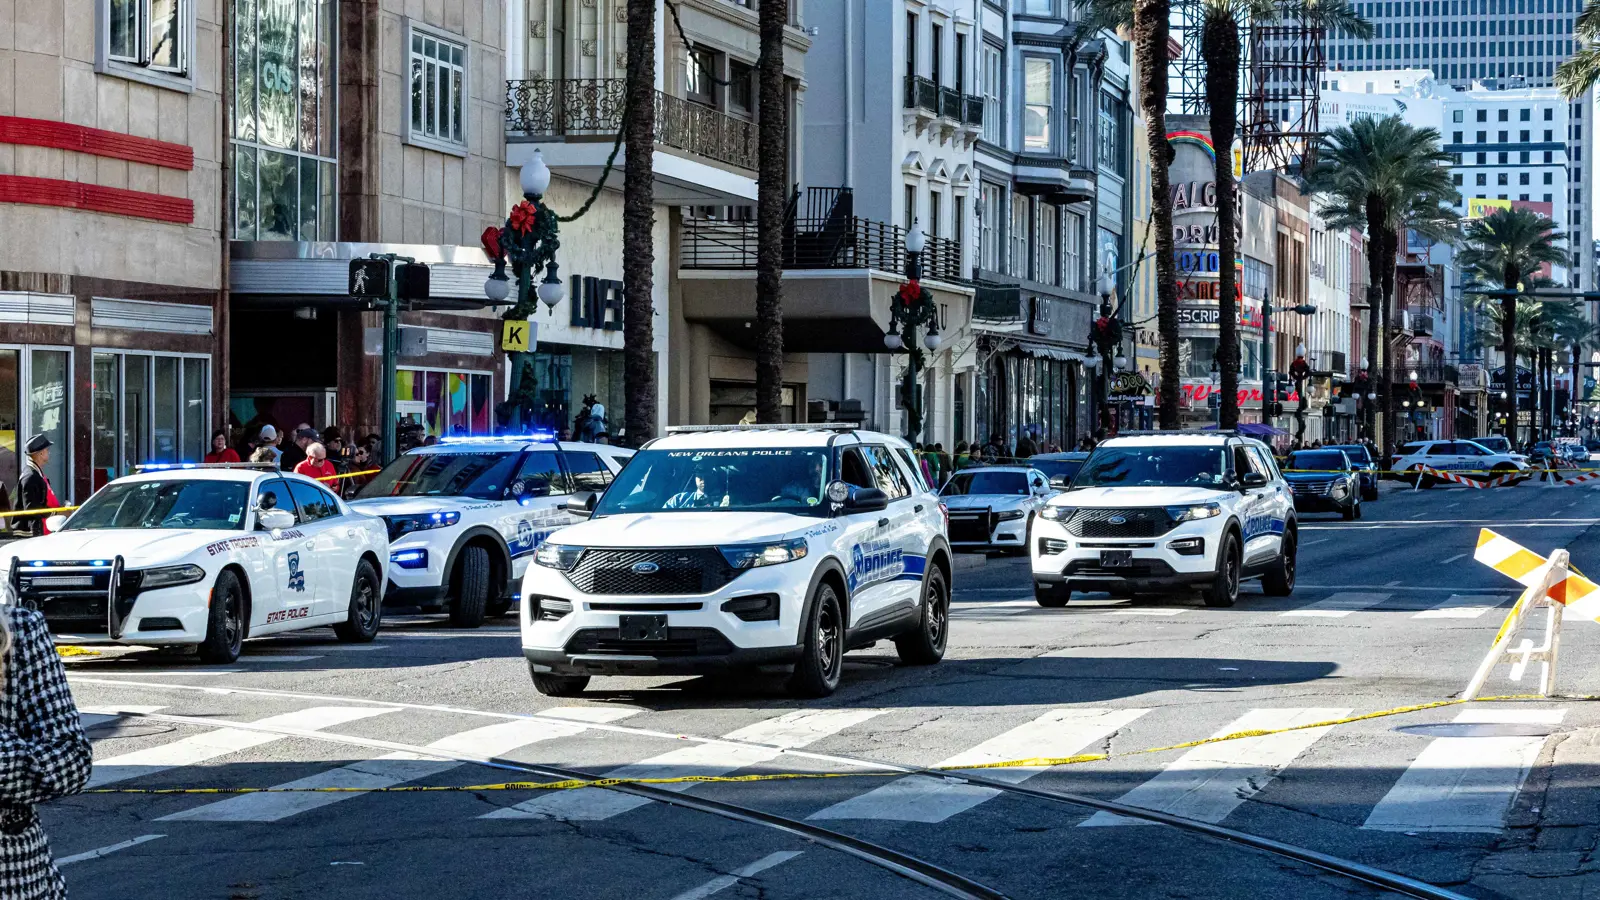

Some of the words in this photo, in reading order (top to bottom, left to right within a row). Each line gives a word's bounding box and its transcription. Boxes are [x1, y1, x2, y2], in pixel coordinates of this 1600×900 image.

[263, 61, 291, 93] CVS
[1173, 223, 1241, 247] DRUS
[509, 326, 522, 345] K
[207, 540, 230, 556] STATE
[864, 547, 903, 574] POLICE
[267, 610, 286, 624] STATE
[287, 607, 309, 619] POLICE
